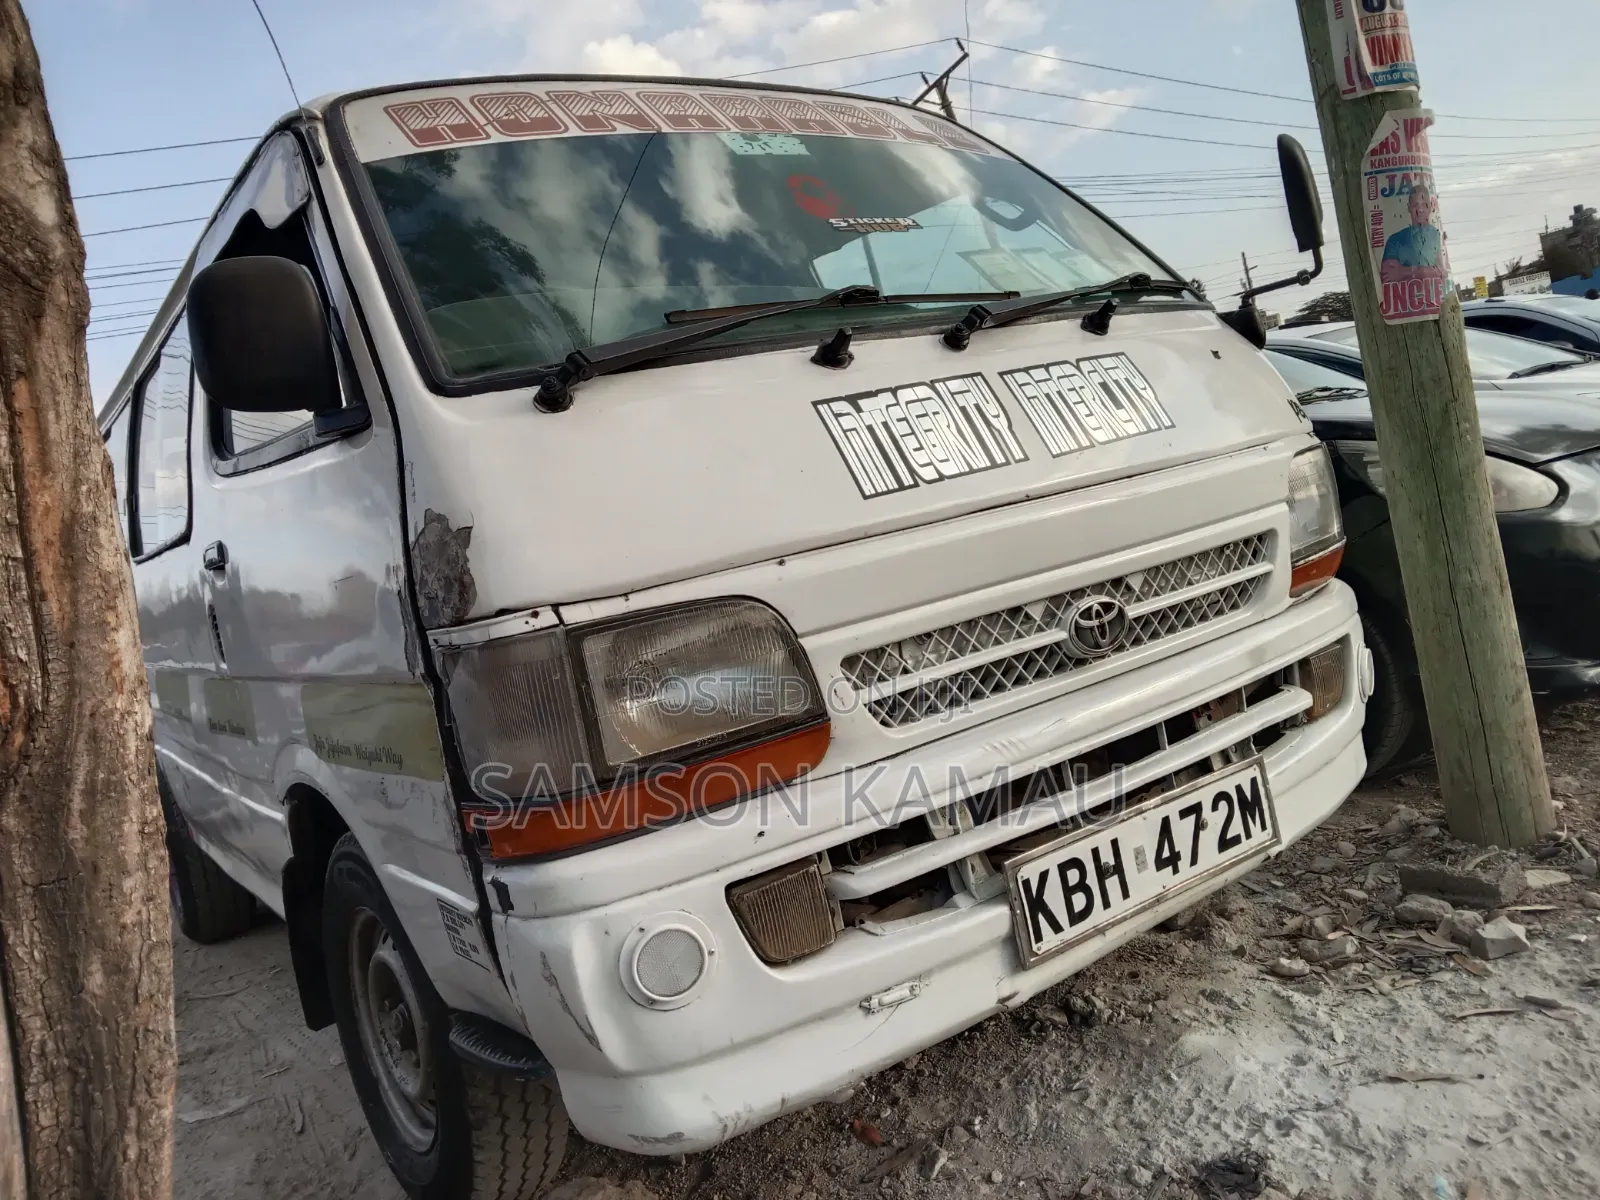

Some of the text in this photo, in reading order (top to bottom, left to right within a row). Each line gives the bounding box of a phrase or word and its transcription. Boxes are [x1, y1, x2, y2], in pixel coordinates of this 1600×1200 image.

[828, 217, 917, 228] STICKER
[853, 223, 909, 233] HUB
[1371, 227, 1385, 248] ENTRY
[1381, 278, 1444, 315] UNCLE
[813, 374, 1028, 499] INTEGRITY
[1021, 776, 1268, 945] KBH 472M
